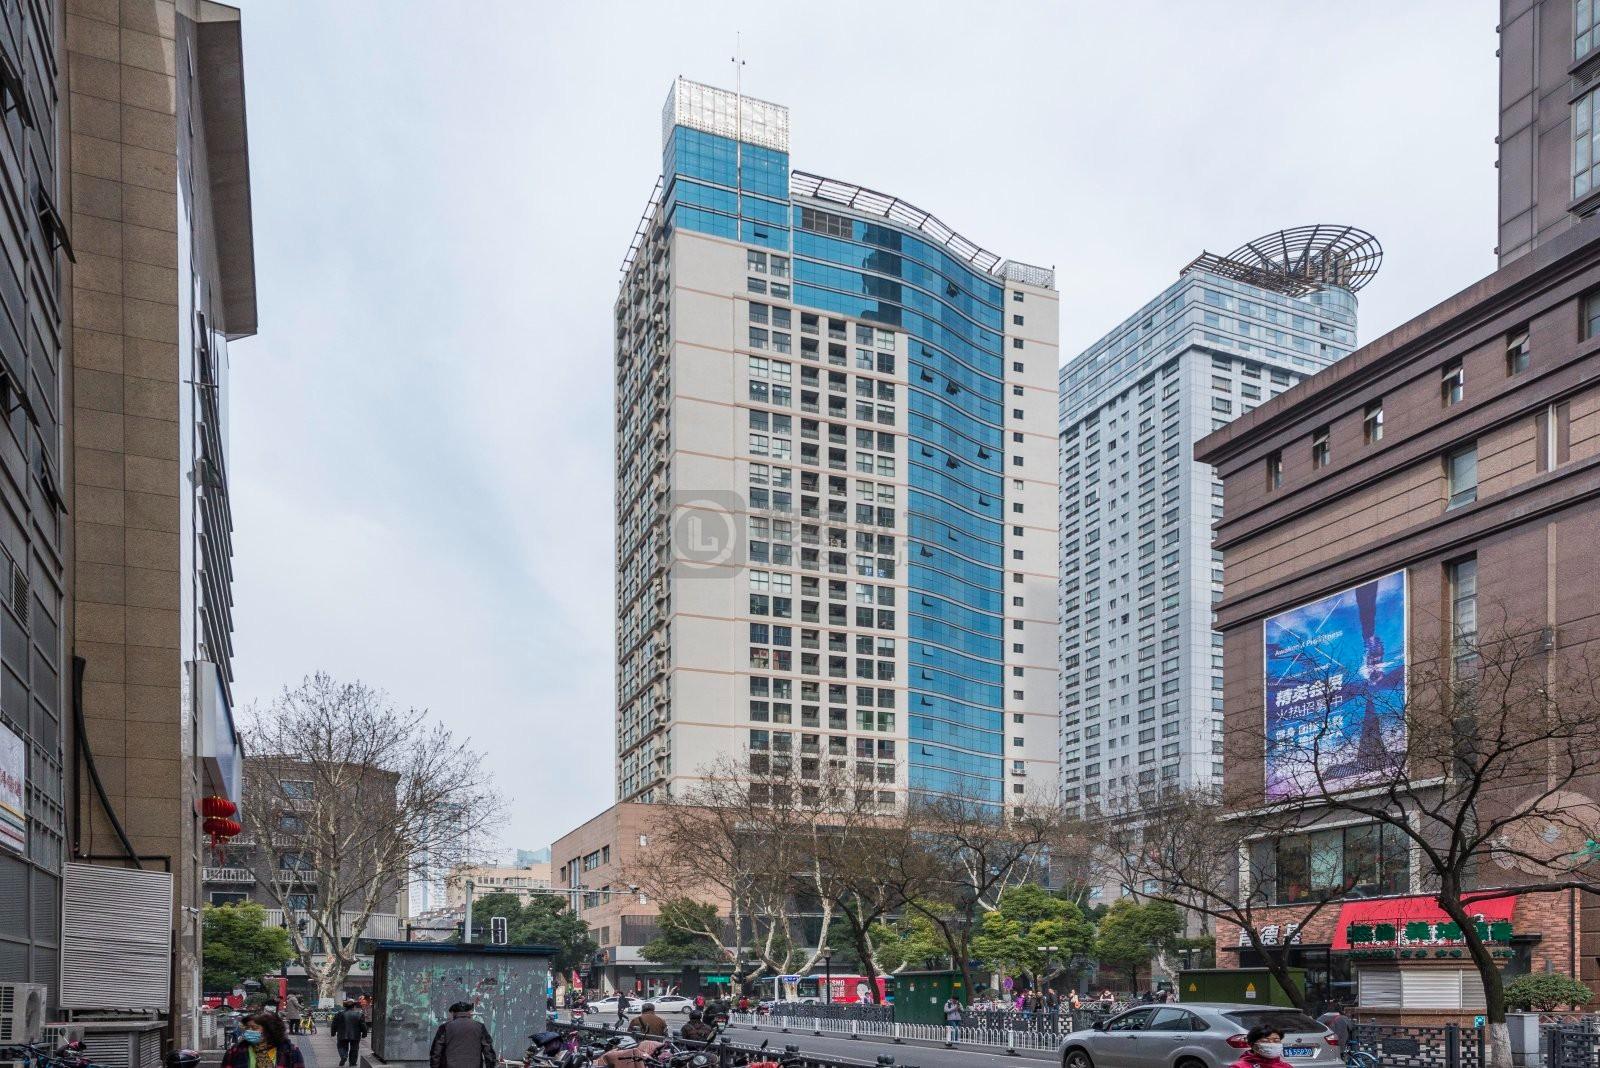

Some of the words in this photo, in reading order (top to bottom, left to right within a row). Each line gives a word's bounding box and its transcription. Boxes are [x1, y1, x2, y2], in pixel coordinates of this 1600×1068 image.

[1276, 695, 1343, 723] 火热招募中
[1239, 923, 1302, 947] 肯德基
